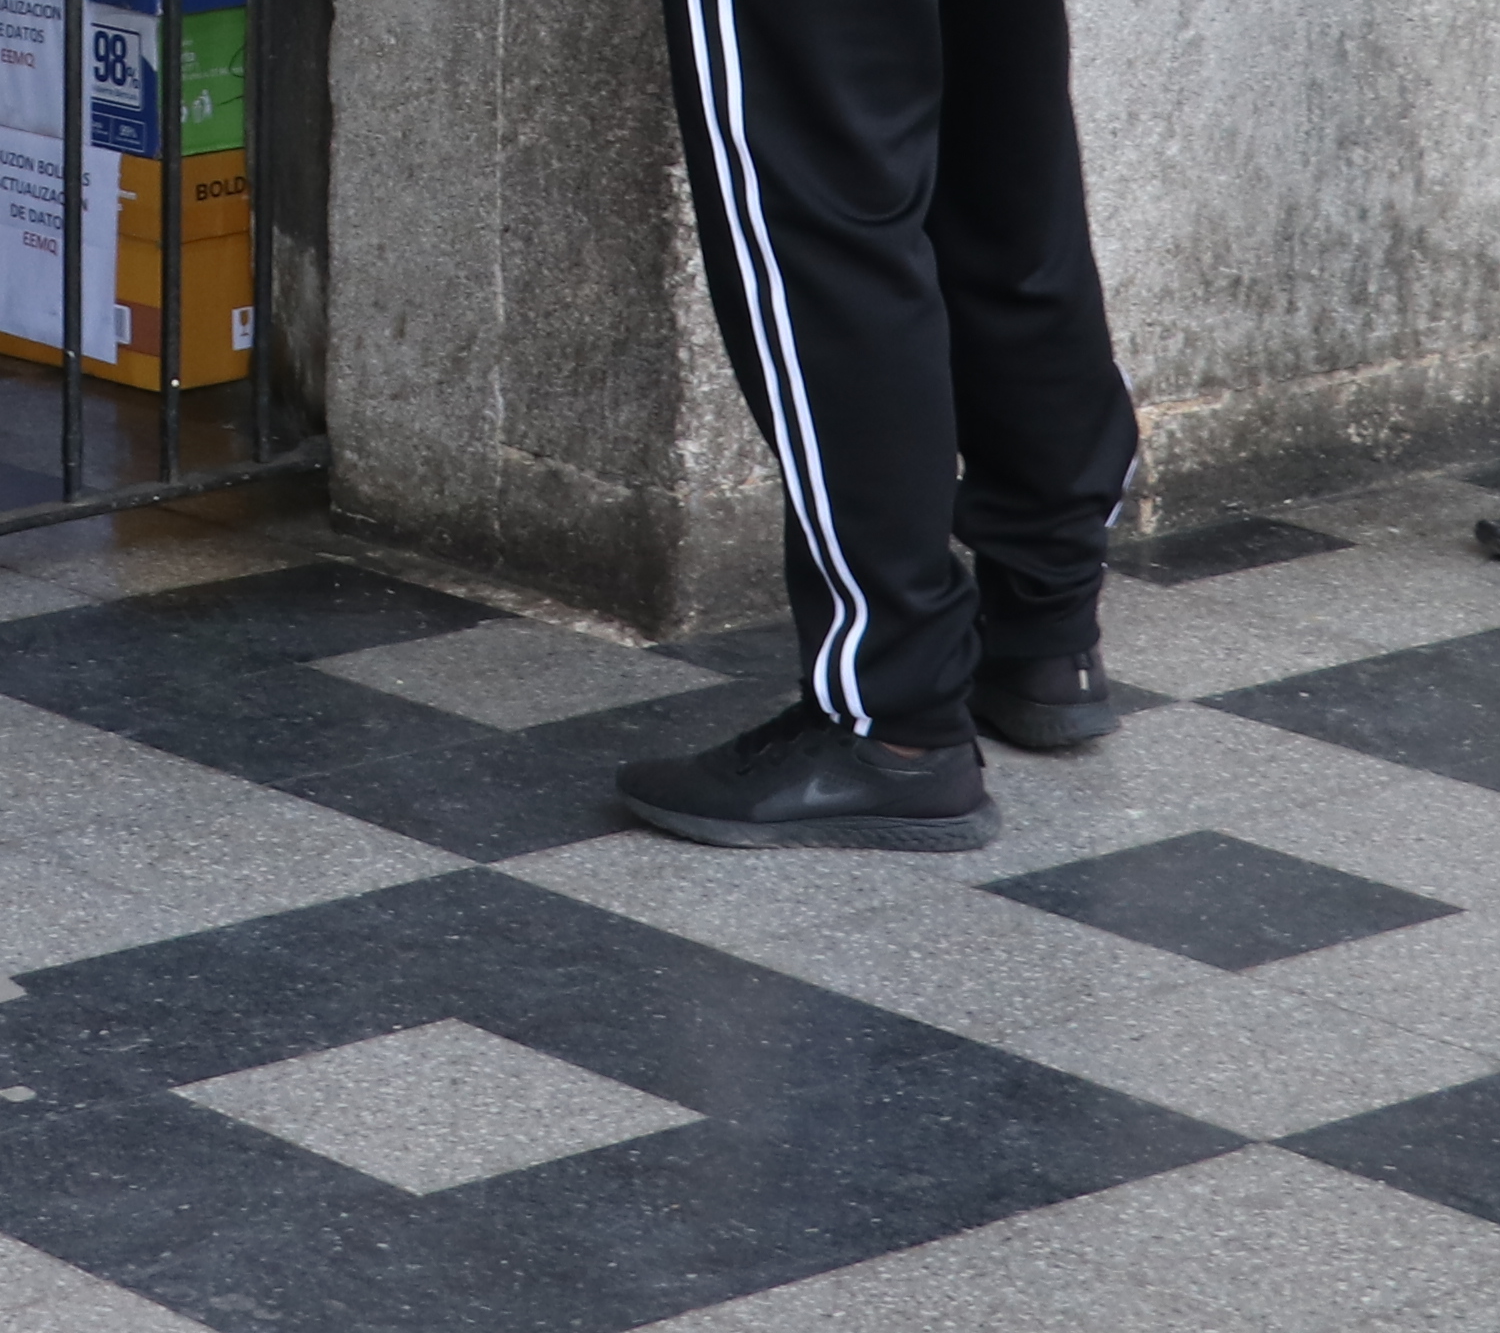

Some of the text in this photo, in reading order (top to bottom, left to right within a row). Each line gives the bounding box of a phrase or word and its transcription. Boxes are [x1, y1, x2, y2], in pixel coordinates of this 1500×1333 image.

[5, 24, 45, 44] DATOS
[0, 47, 36, 70] EEMQ
[37, 159, 91, 188] BOLS
[9, 202, 64, 231] DE DATO
[22, 231, 59, 256] EEMQ
